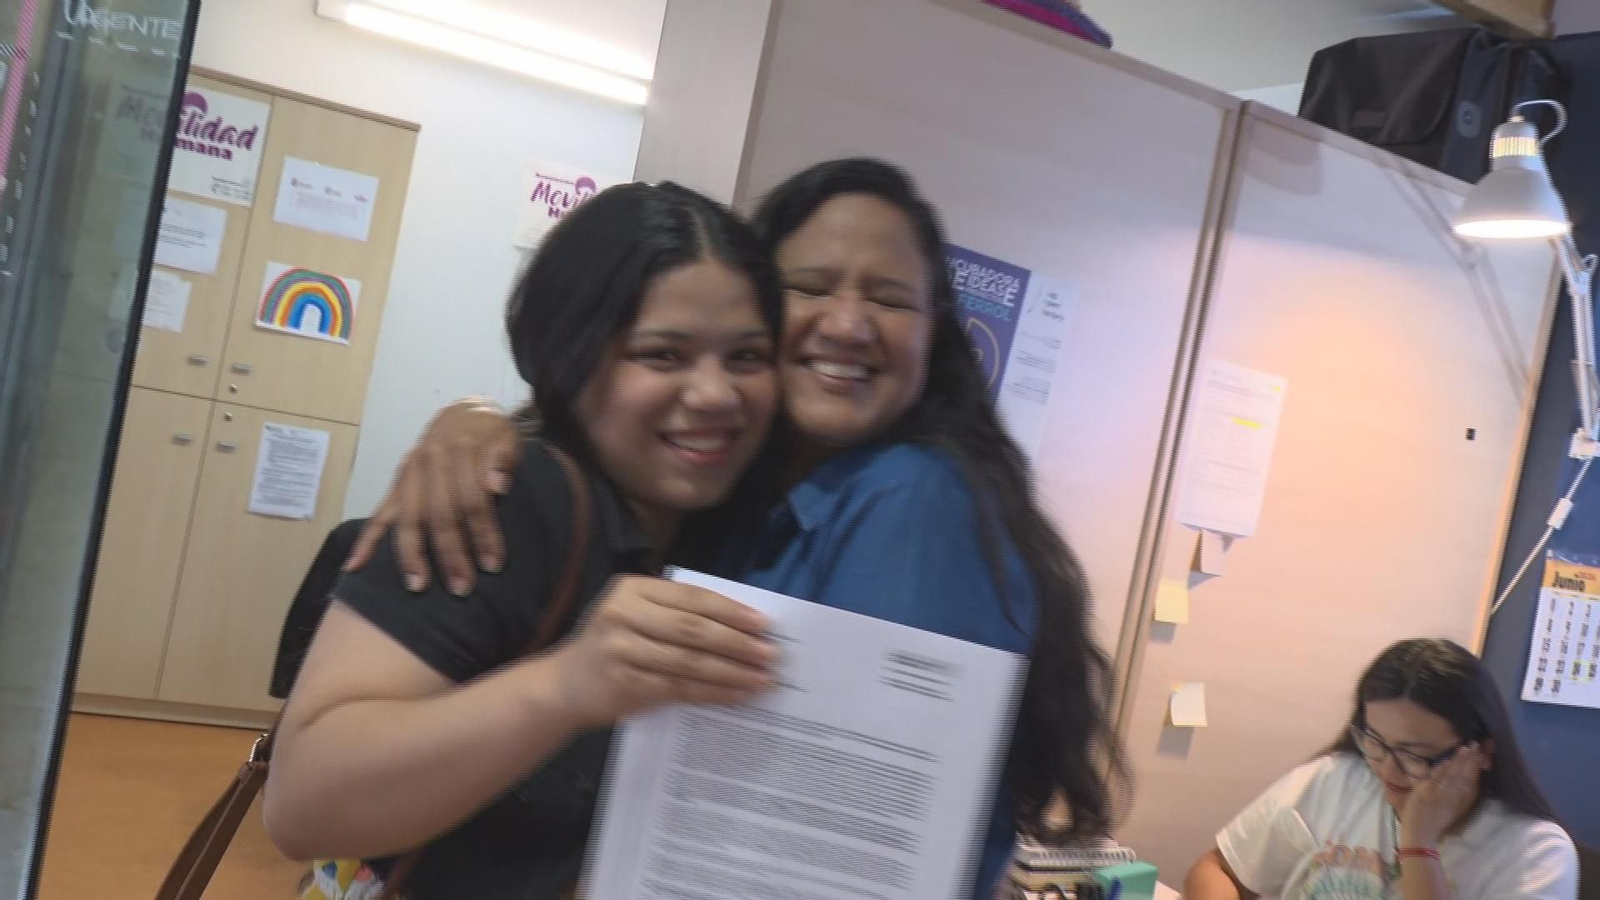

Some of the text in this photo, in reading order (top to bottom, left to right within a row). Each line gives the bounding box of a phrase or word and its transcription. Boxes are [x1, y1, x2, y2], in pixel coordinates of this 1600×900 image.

[64, 0, 181, 39] URGENTE
[946, 256, 1020, 291] NCUBADORA
[1551, 571, 1586, 593] Junio
